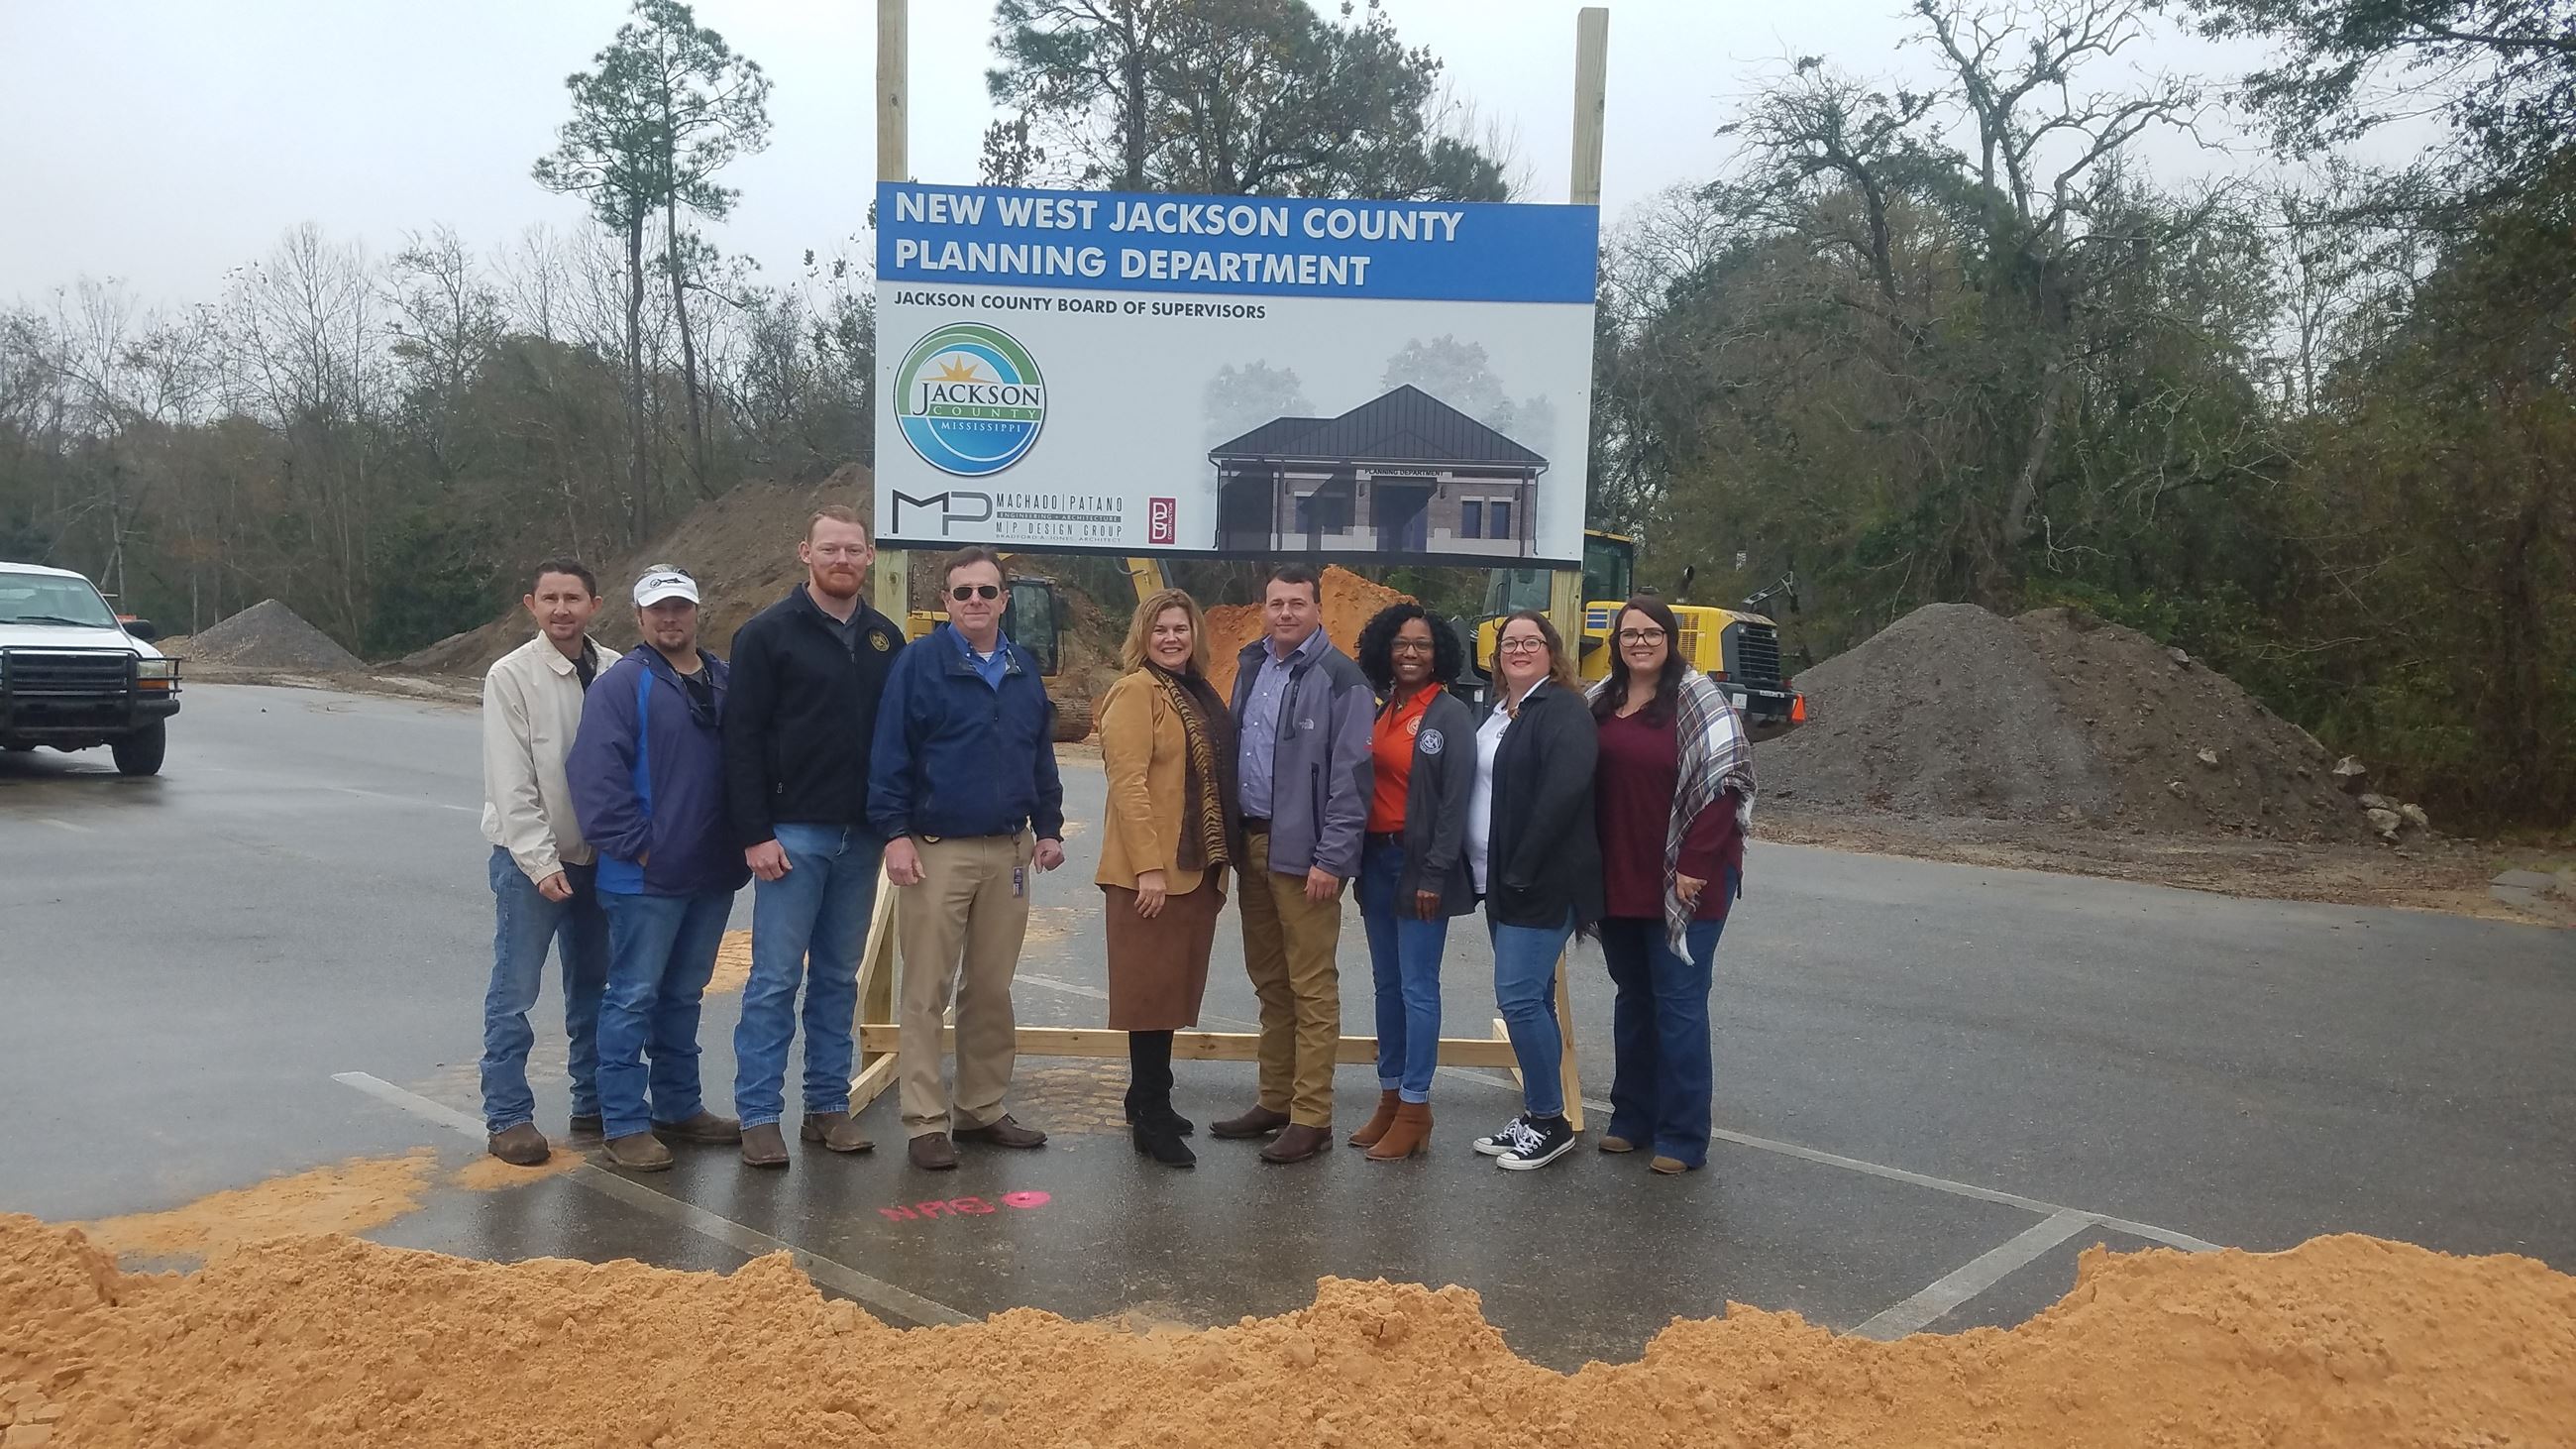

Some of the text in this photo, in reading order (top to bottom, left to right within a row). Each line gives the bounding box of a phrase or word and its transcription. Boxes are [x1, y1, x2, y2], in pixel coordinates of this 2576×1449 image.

[896, 191, 1465, 242] NEW WEST JACKSON COUNTY
[896, 239, 1371, 285] PLANNING DEPARTMENT
[894, 290, 1266, 320] JACKSON COUNTY BOARD OF SUPERVISORS
[912, 383, 1040, 416] JACKSON
[932, 406, 1036, 418] COUNTY
[940, 421, 1021, 433] MISSISSIPPI
[892, 489, 993, 536] MP
[996, 493, 1123, 512] MACHADO PATANO
[1028, 522, 1073, 535] DESIGN
[1084, 524, 1123, 537] GROUP
